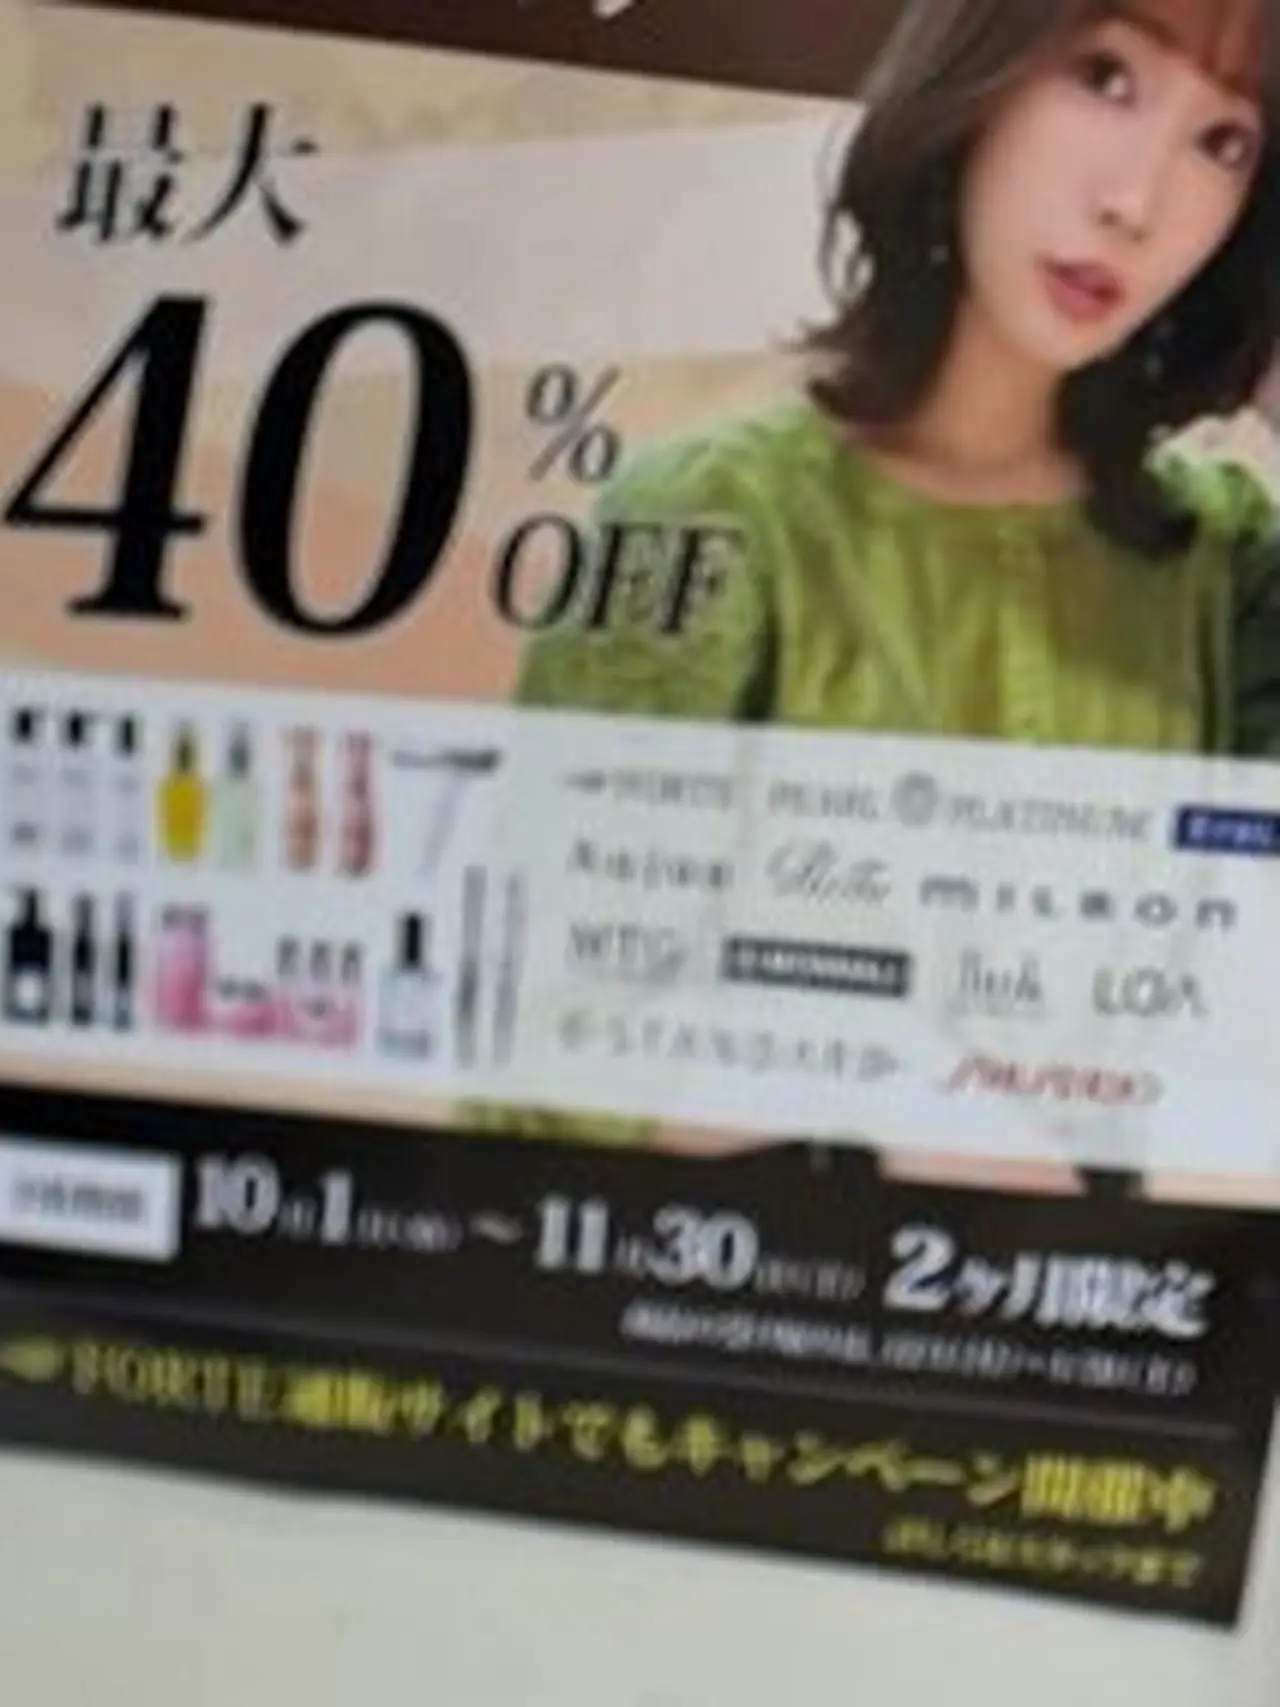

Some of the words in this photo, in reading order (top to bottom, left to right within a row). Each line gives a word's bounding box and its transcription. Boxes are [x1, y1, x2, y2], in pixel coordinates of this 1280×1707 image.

[54, 102, 322, 246] 最大
[523, 364, 622, 485] %
[490, 511, 746, 637] OFF
